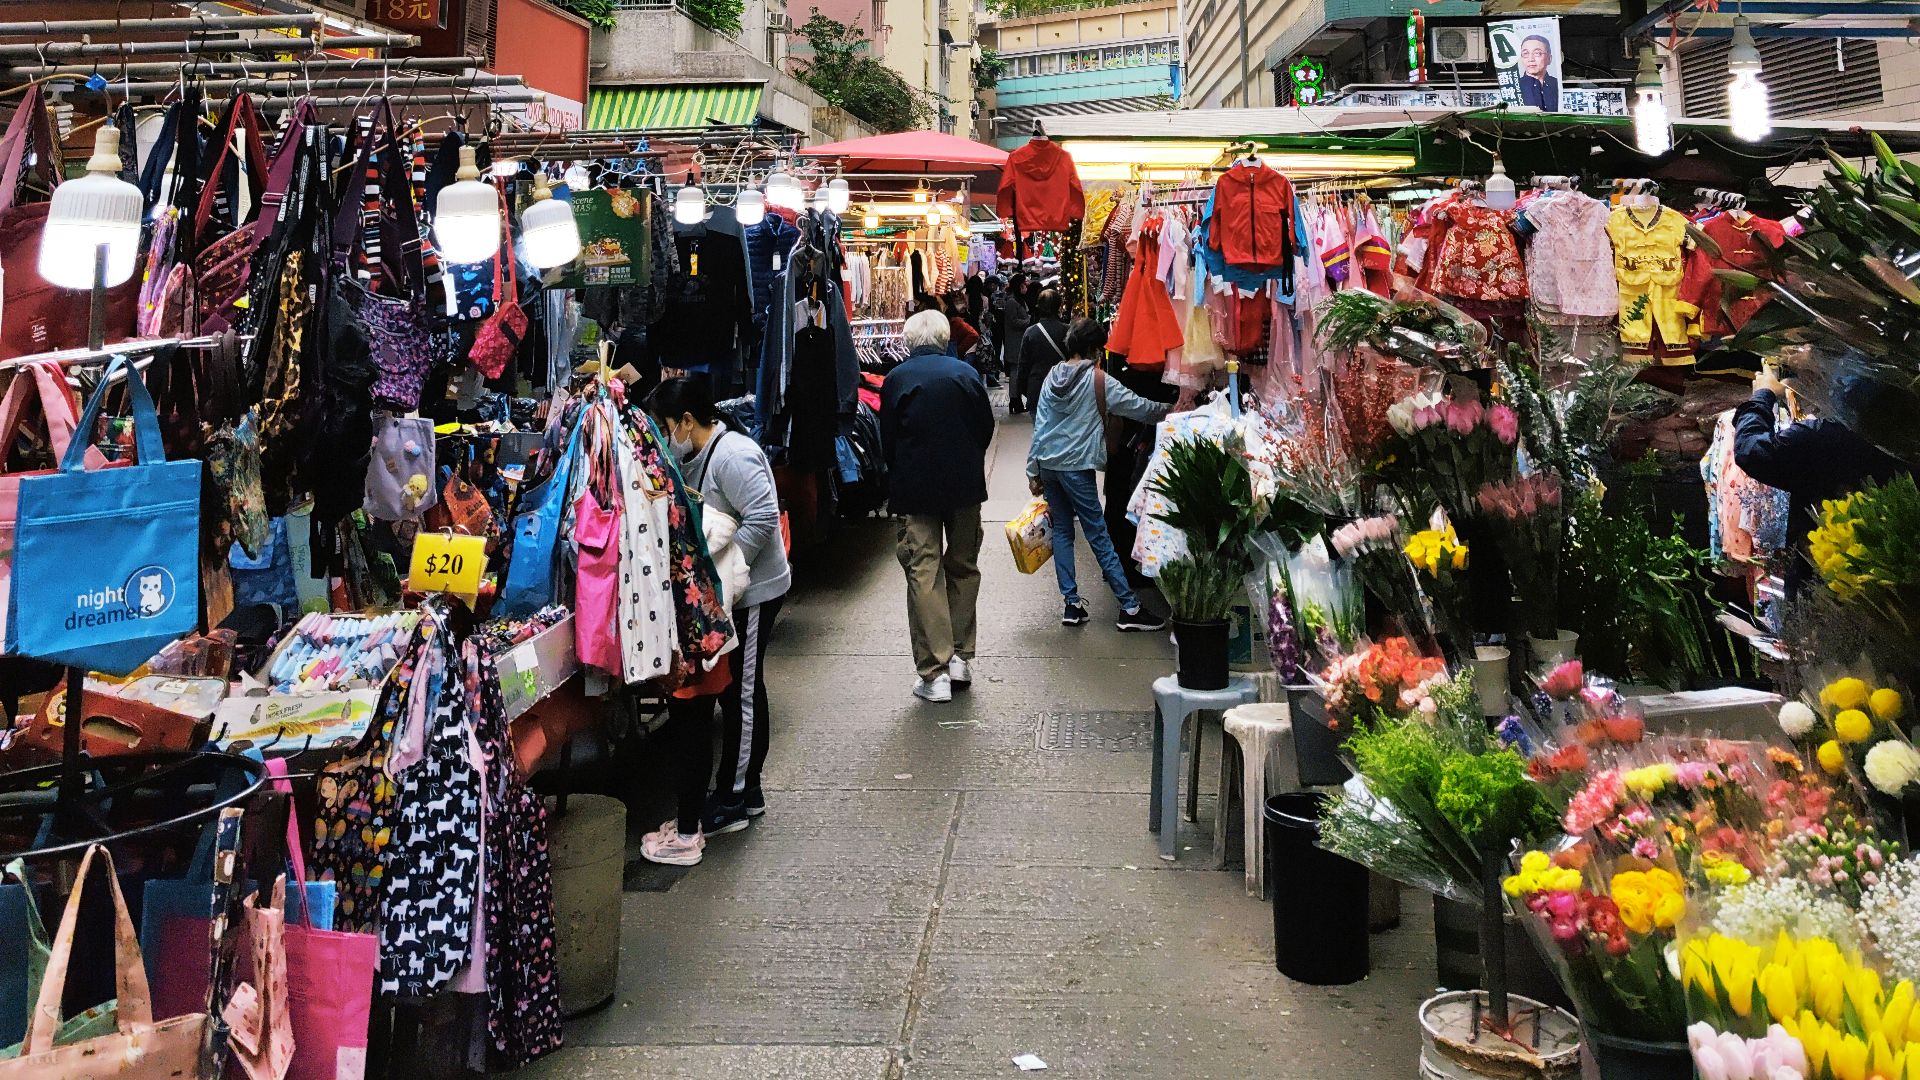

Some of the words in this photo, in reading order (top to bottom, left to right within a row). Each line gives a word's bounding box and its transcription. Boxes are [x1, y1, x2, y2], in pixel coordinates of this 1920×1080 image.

[1493, 33, 1517, 64] 4
[424, 553, 464, 577] $20
[77, 586, 125, 610] night
[65, 604, 154, 631] dreamers
[283, 702, 303, 713] FRESH
